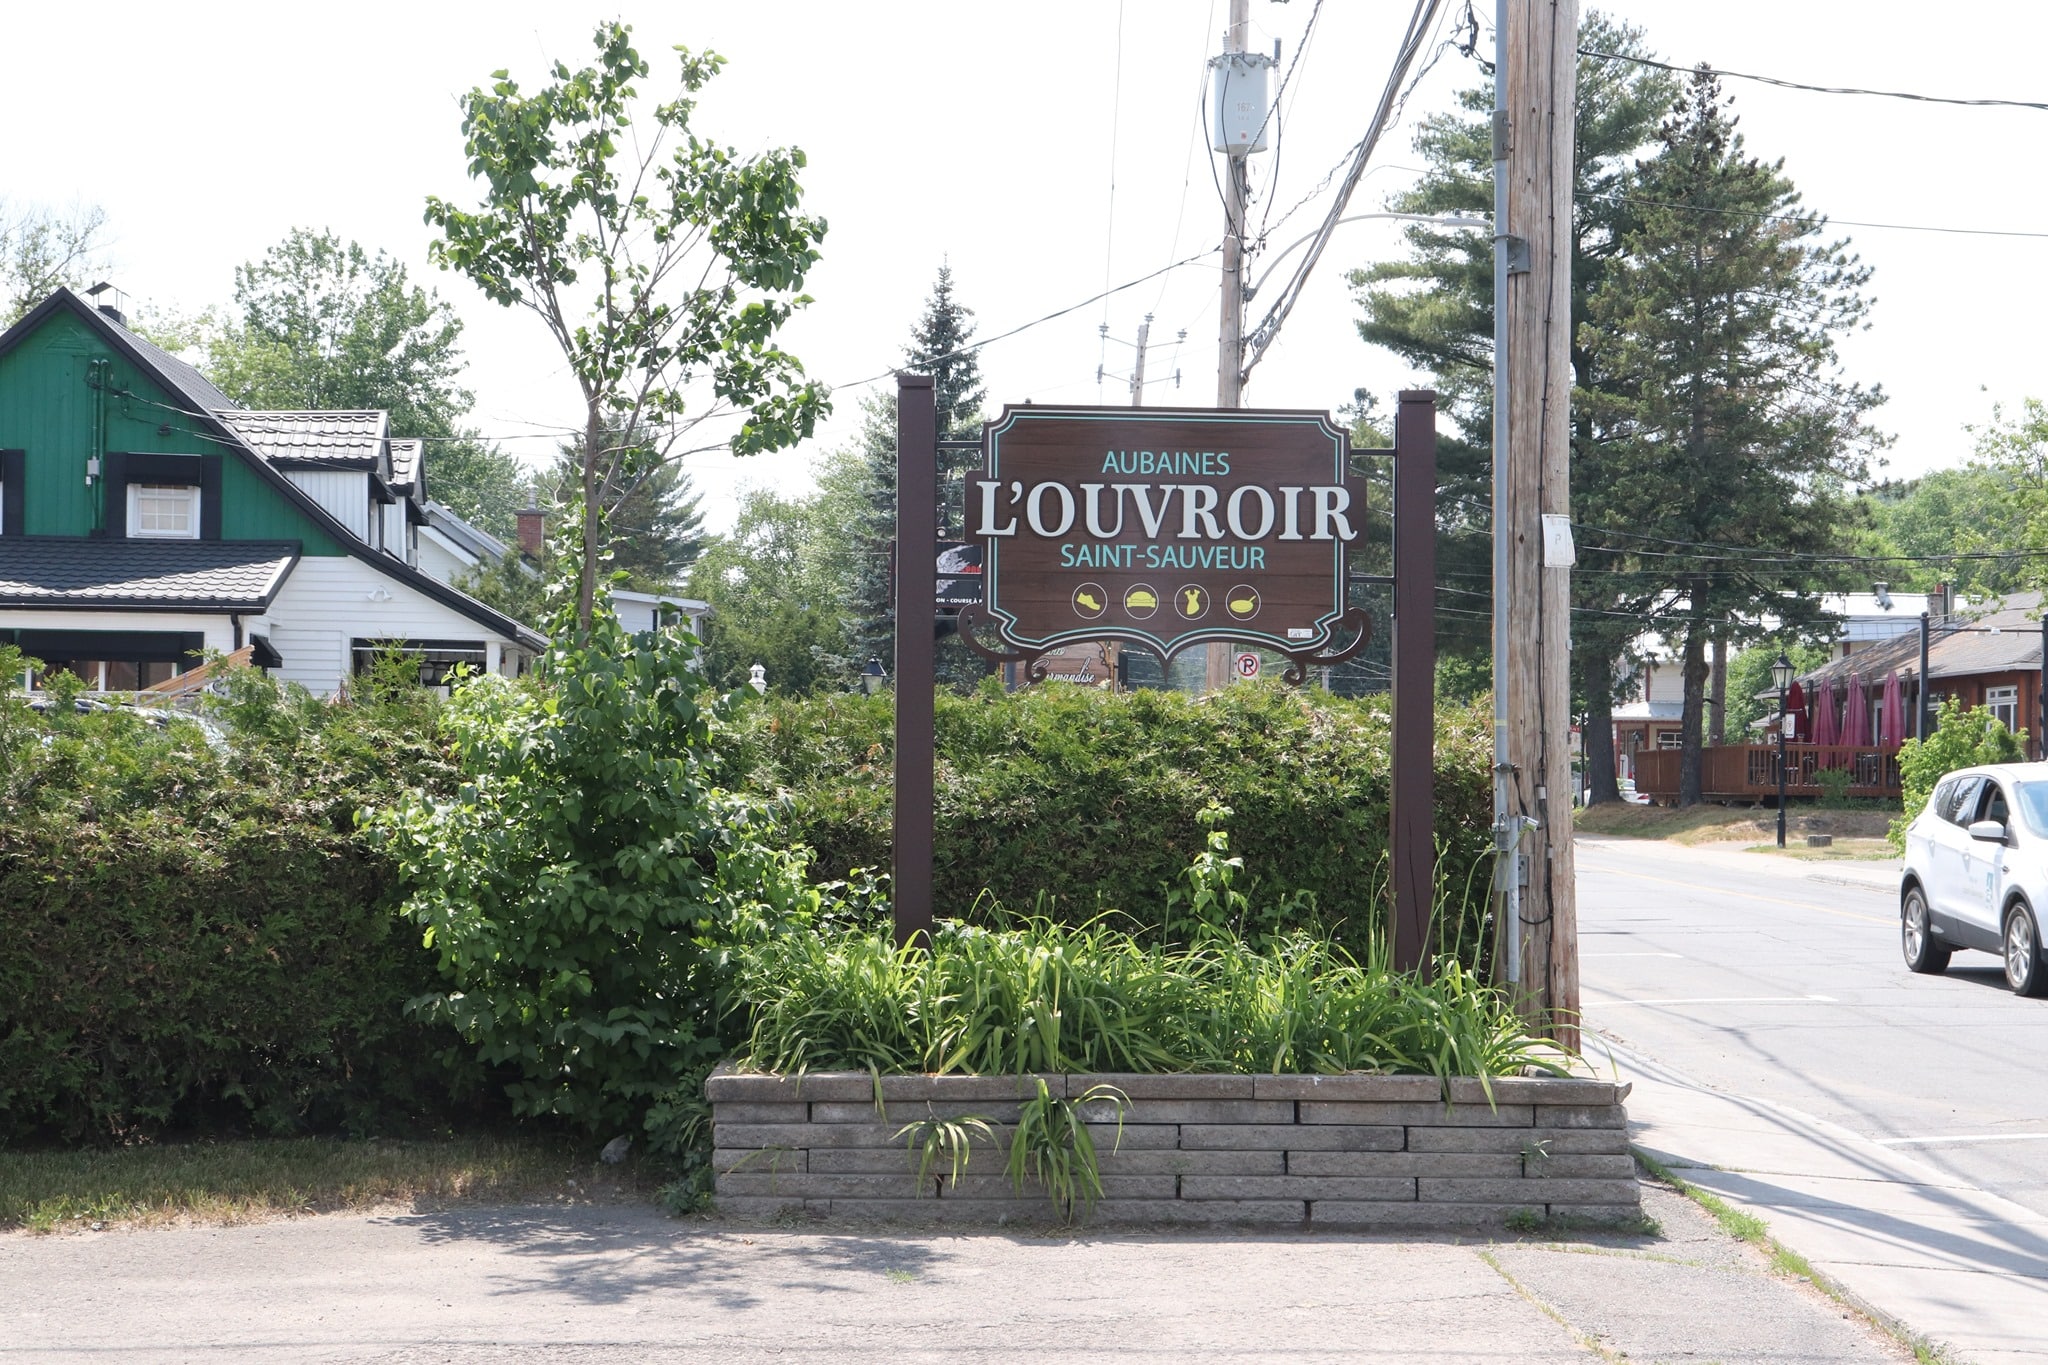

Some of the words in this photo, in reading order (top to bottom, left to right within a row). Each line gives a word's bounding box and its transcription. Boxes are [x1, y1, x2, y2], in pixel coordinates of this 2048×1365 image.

[1101, 450, 1230, 476] AUBAINES
[976, 480, 1358, 542] L'OUVROIR
[1060, 543, 1265, 570] SAINT-SAUVEUR
[1032, 656, 1095, 683] rmandise
[1243, 658, 1254, 673] P
